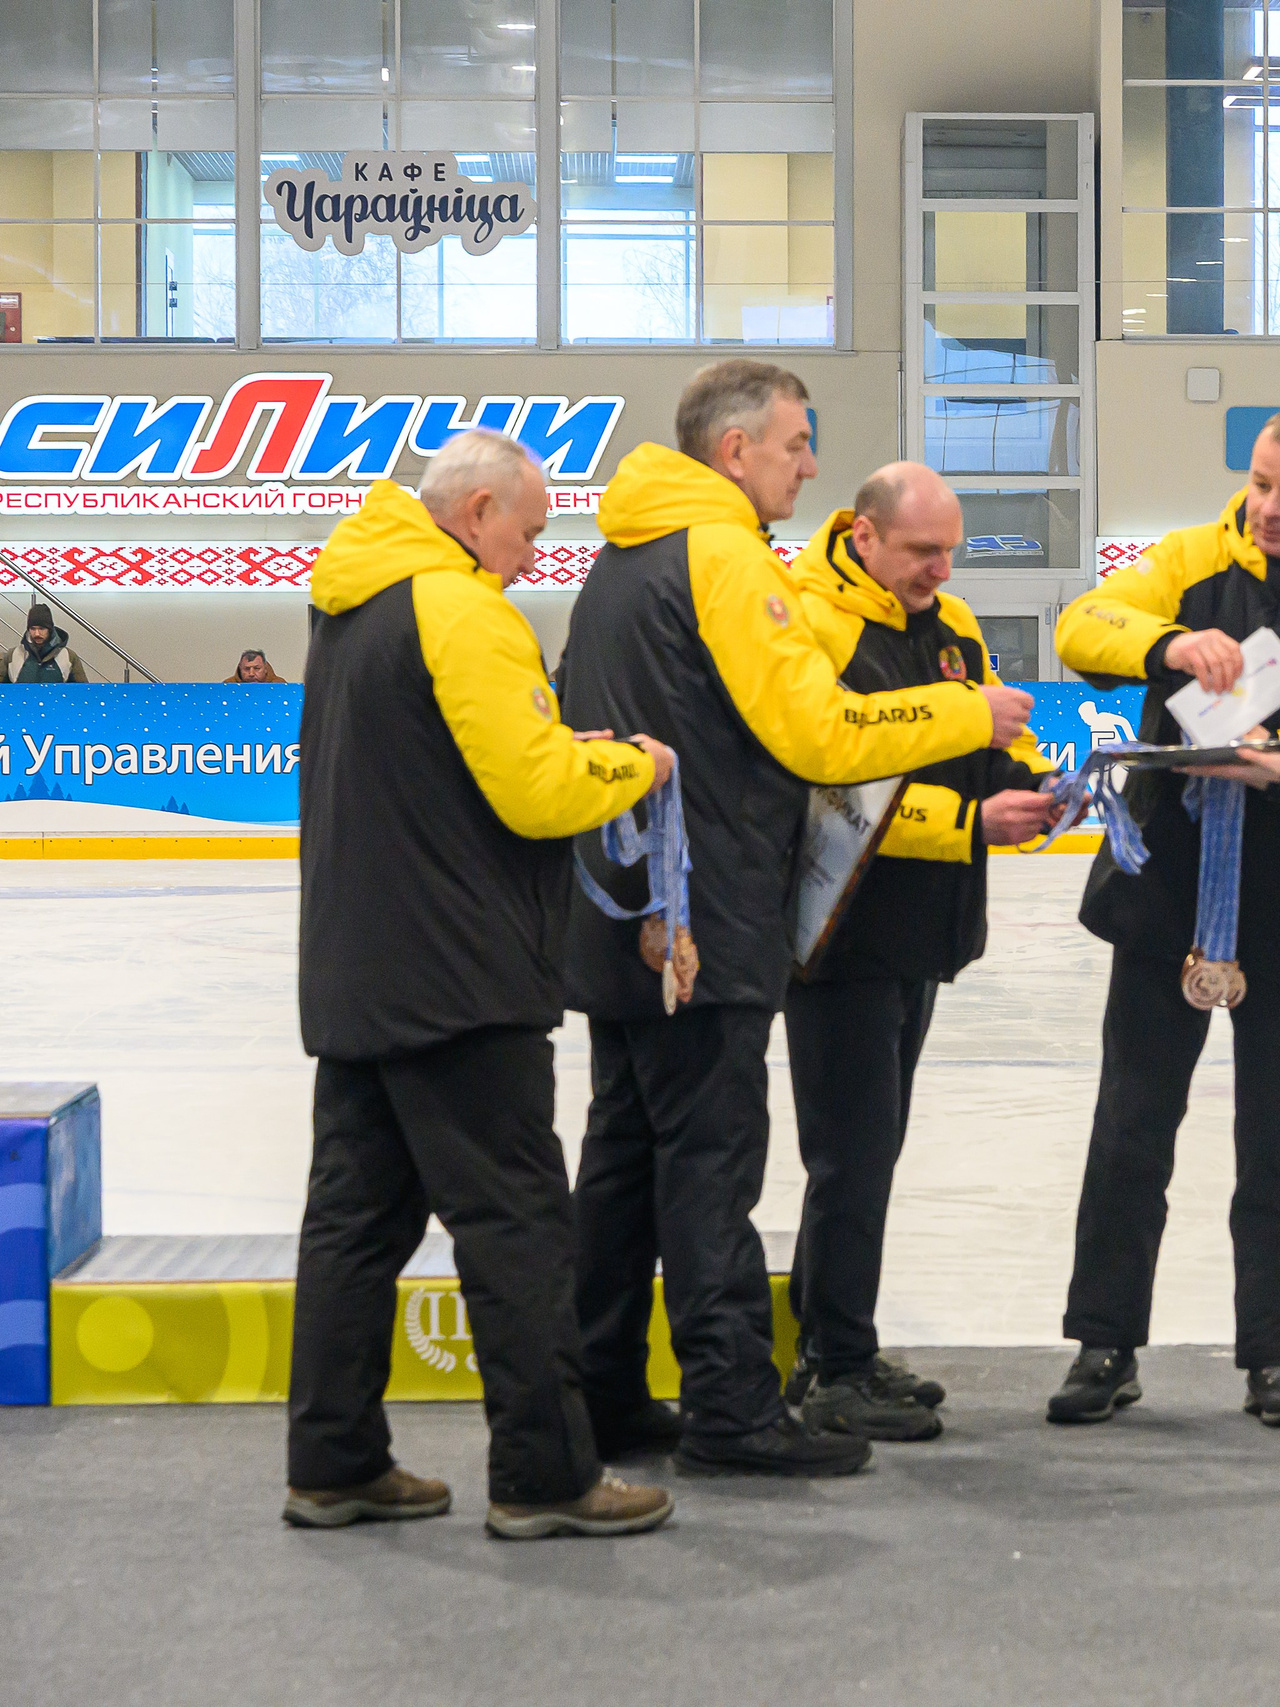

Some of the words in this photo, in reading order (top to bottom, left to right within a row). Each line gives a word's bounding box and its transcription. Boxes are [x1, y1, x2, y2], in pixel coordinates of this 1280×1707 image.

[354, 162, 446, 181] КАФЕ
[276, 180, 525, 244] Чараўніца
[293, 493, 363, 508] ГОРН
[22, 733, 301, 786] Управления
